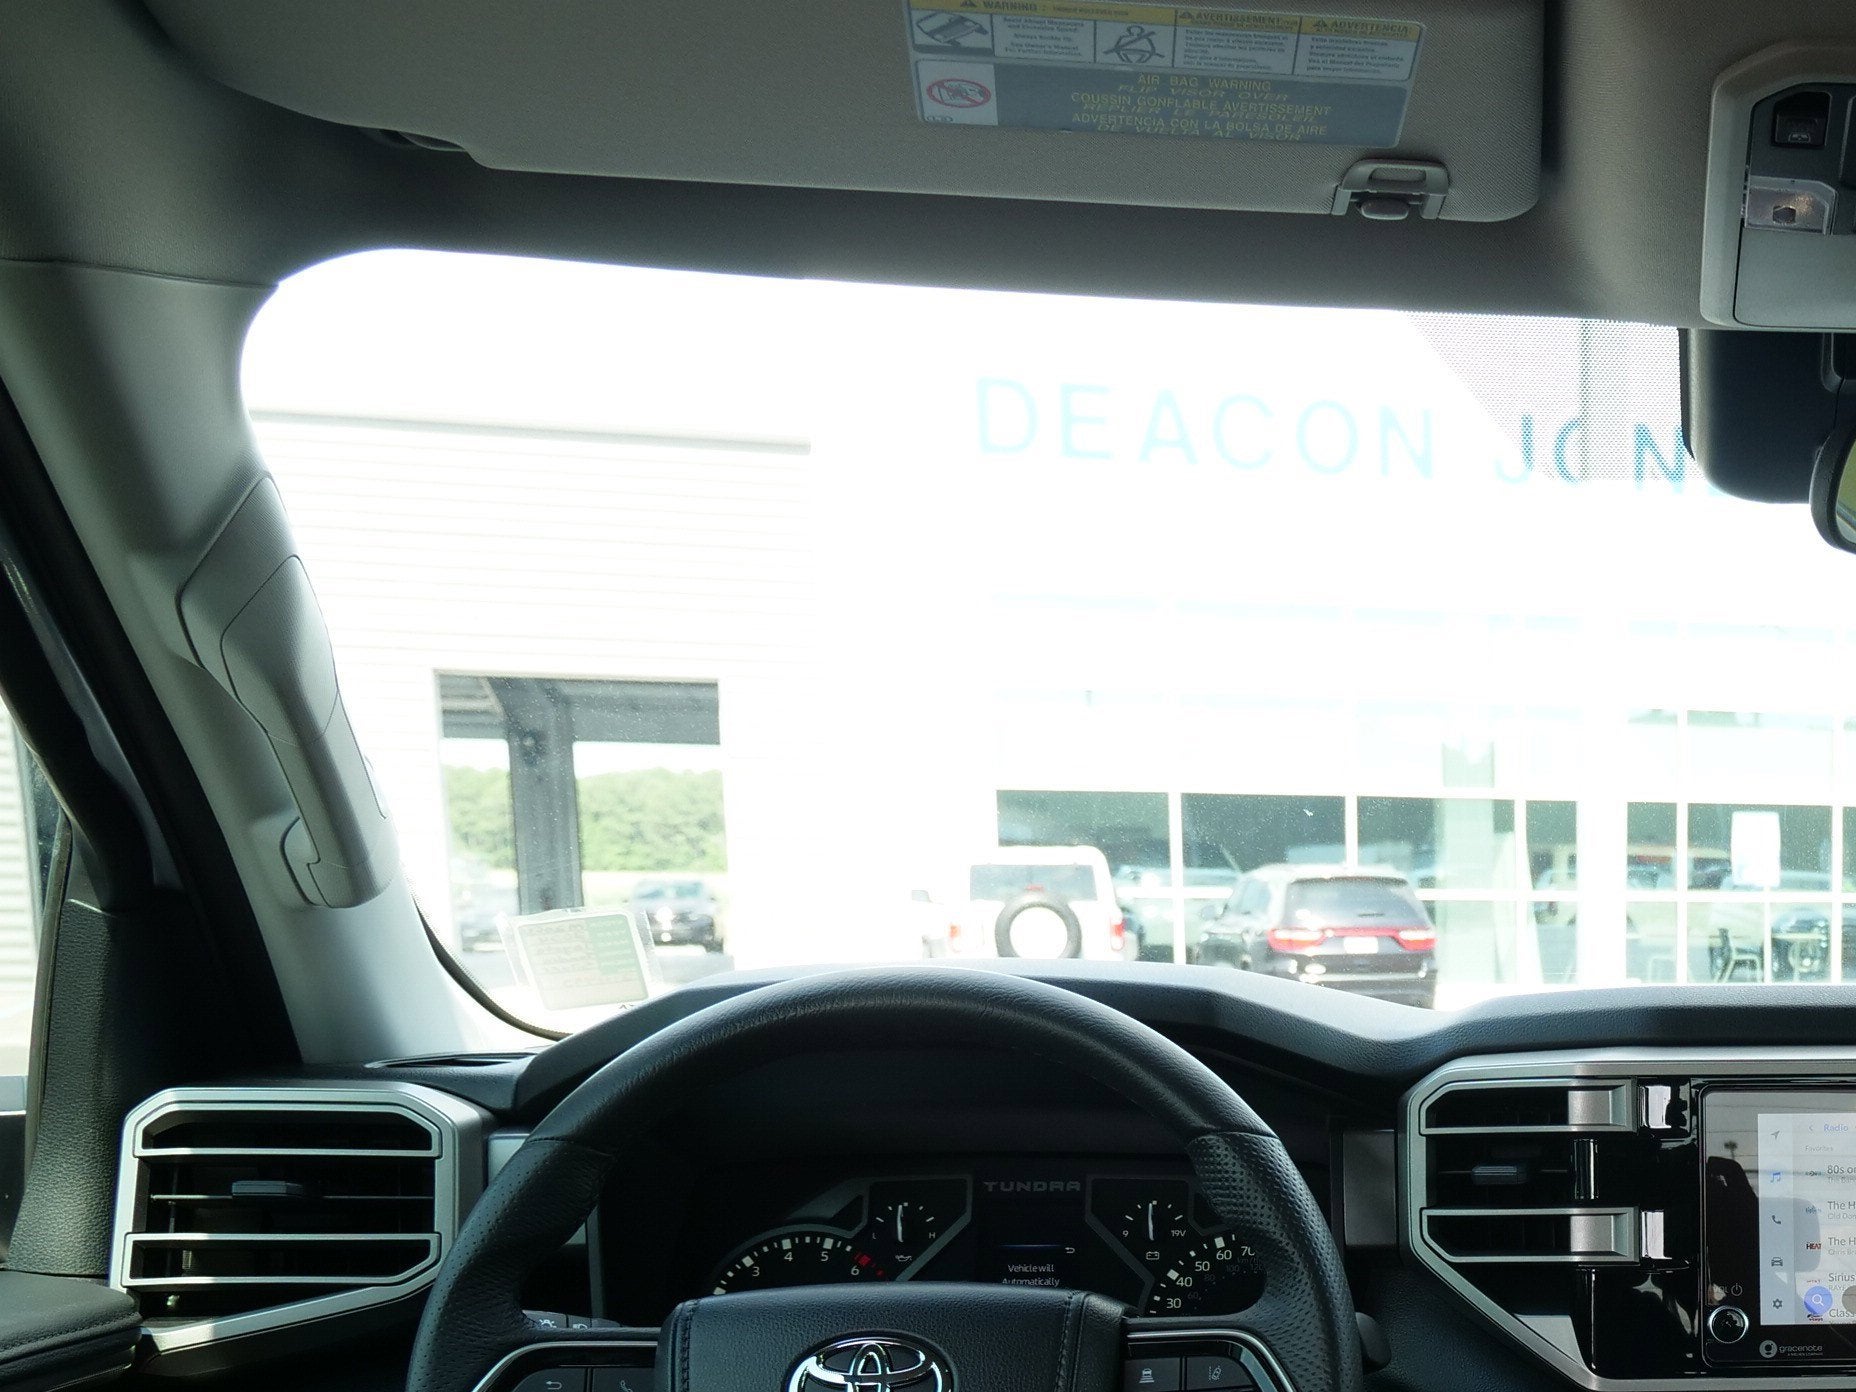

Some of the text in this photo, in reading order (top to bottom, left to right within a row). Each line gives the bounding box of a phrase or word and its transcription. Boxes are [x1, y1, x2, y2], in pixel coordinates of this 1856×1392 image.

[1138, 74, 1272, 91] AIR BAG WARNING
[1071, 92, 1332, 117] COUSSIN GONFLABLE AVERTISSEMENT
[1072, 113, 1327, 136] ADVERTENCIA CON LA BOLSA DE AIRE
[975, 375, 1720, 497] DEACON JON
[1823, 1123, 1849, 1132] Radio
[1827, 1165, 1845, 1174] 80s
[983, 1180, 1081, 1192] TUNDRA
[1827, 1200, 1846, 1210] The
[929, 1231, 937, 1239] H
[1122, 1230, 1129, 1238] 9
[1170, 1229, 1187, 1237] 19V
[1828, 1237, 1846, 1246] The
[783, 1251, 795, 1262] 4
[821, 1251, 830, 1262] 5
[1215, 1249, 1232, 1261] 60
[752, 1265, 761, 1277] 3
[851, 1265, 861, 1276] 6
[1007, 1263, 1055, 1273] Vehicle will
[1194, 1261, 1210, 1272] 50
[1001, 1278, 1060, 1287] Automatically
[1175, 1276, 1193, 1287] 40
[1166, 1298, 1182, 1309] 30
[1778, 1344, 1823, 1354] gracenote
